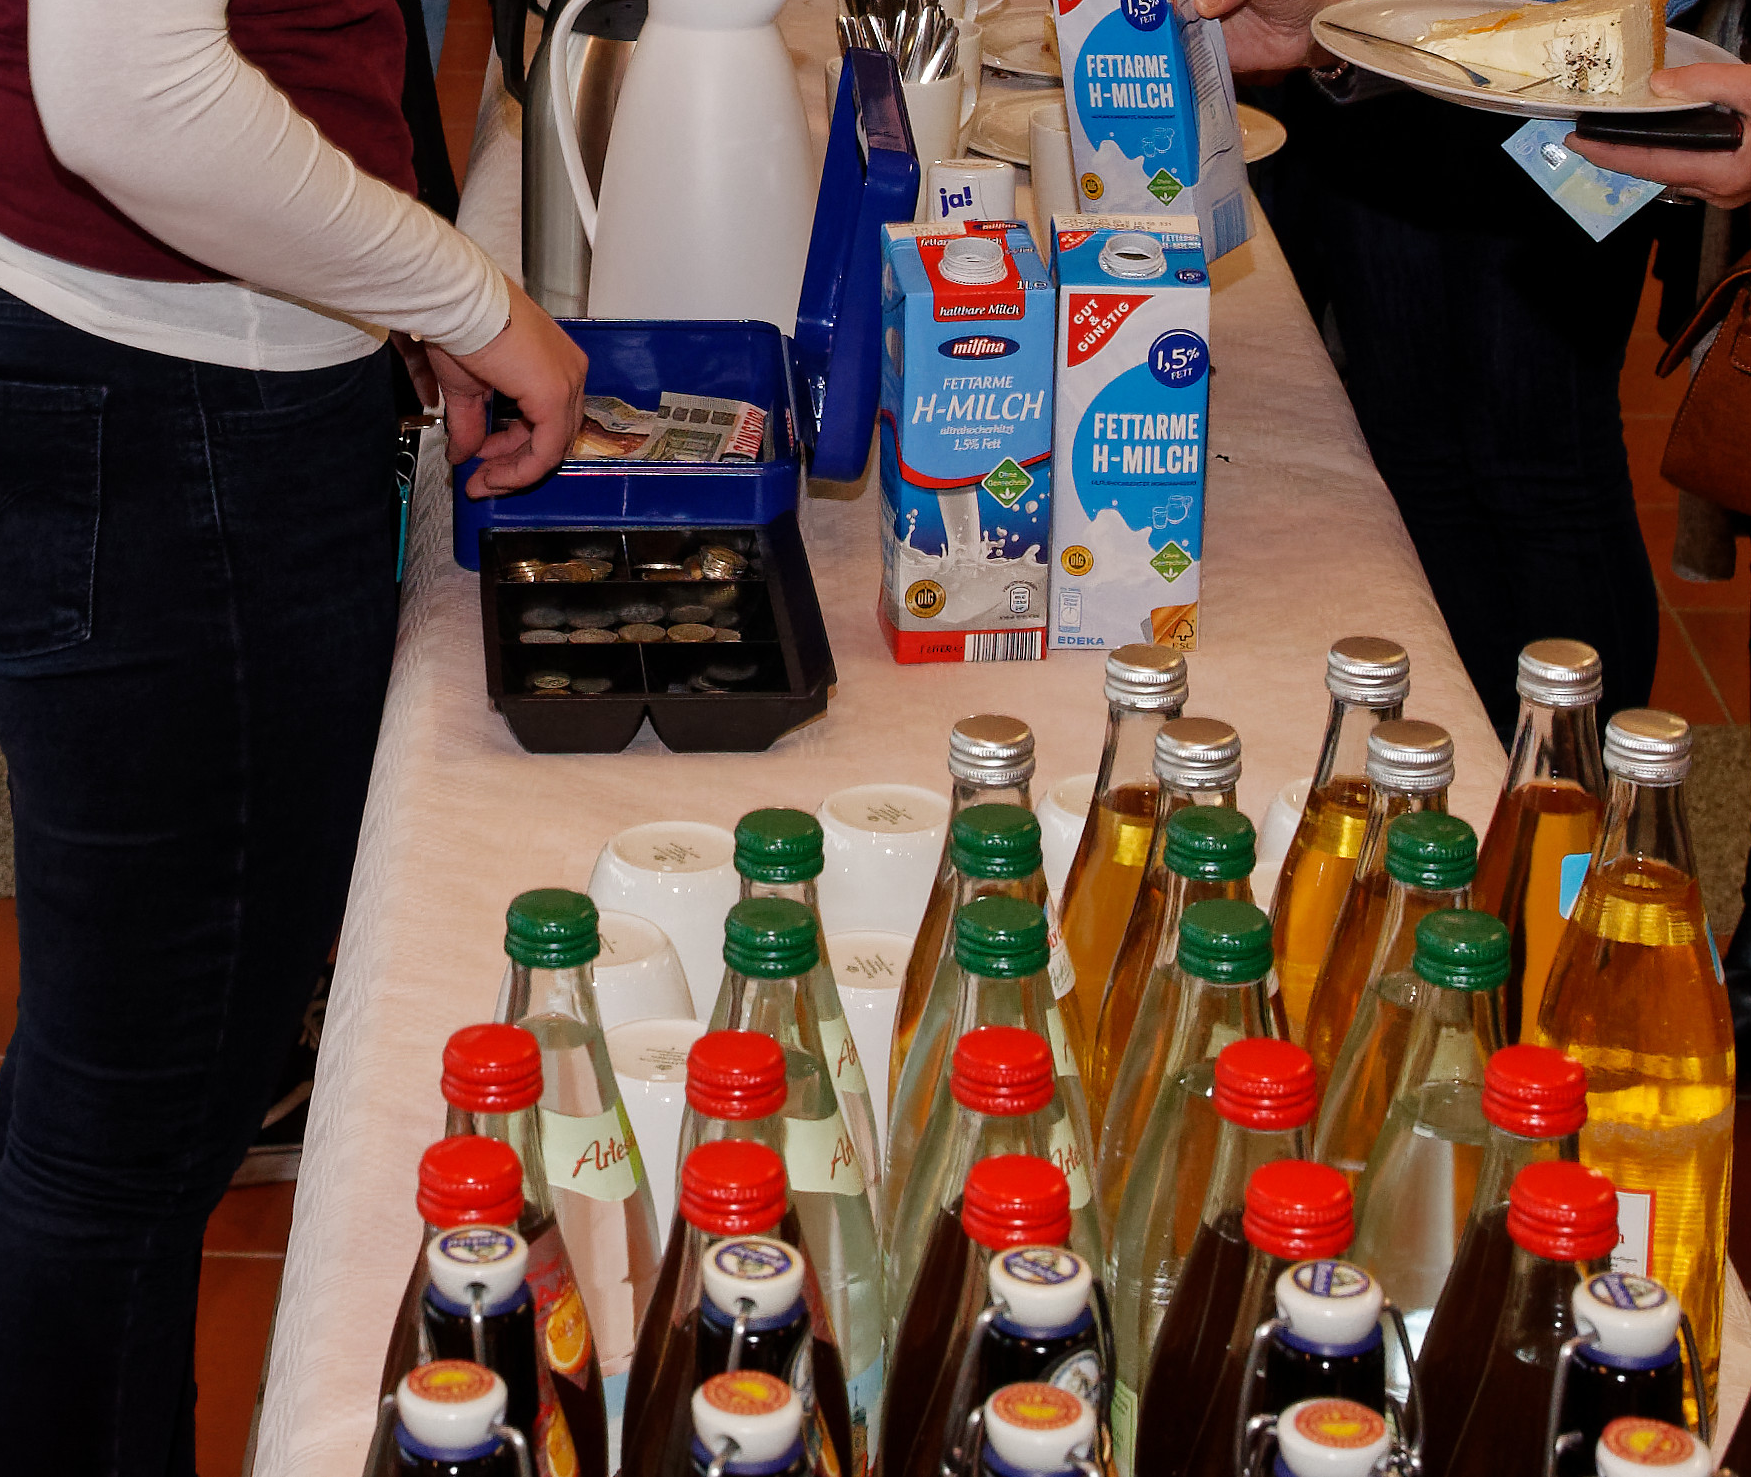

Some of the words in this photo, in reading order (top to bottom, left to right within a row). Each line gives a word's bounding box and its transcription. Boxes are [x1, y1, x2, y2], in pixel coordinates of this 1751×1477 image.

[1086, 54, 1171, 79] FETTARME
[1088, 82, 1175, 109] H-MILCH
[939, 186, 973, 218] ja!
[939, 305, 986, 317] haltbare
[988, 304, 1020, 316] Milch
[1073, 298, 1099, 325] GUT
[1088, 315, 1101, 327] &
[1077, 301, 1130, 353] GÜNSTIG
[952, 338, 1006, 355] milfina
[1157, 347, 1200, 373] 1,5%
[942, 376, 1014, 391] FETTARME
[1171, 368, 1193, 380] FETT
[911, 390, 1045, 425] H-MILCH
[1093, 412, 1200, 440] FETTARME
[1092, 444, 1199, 475] H-MILCH
[1057, 636, 1105, 646] EDEKA
